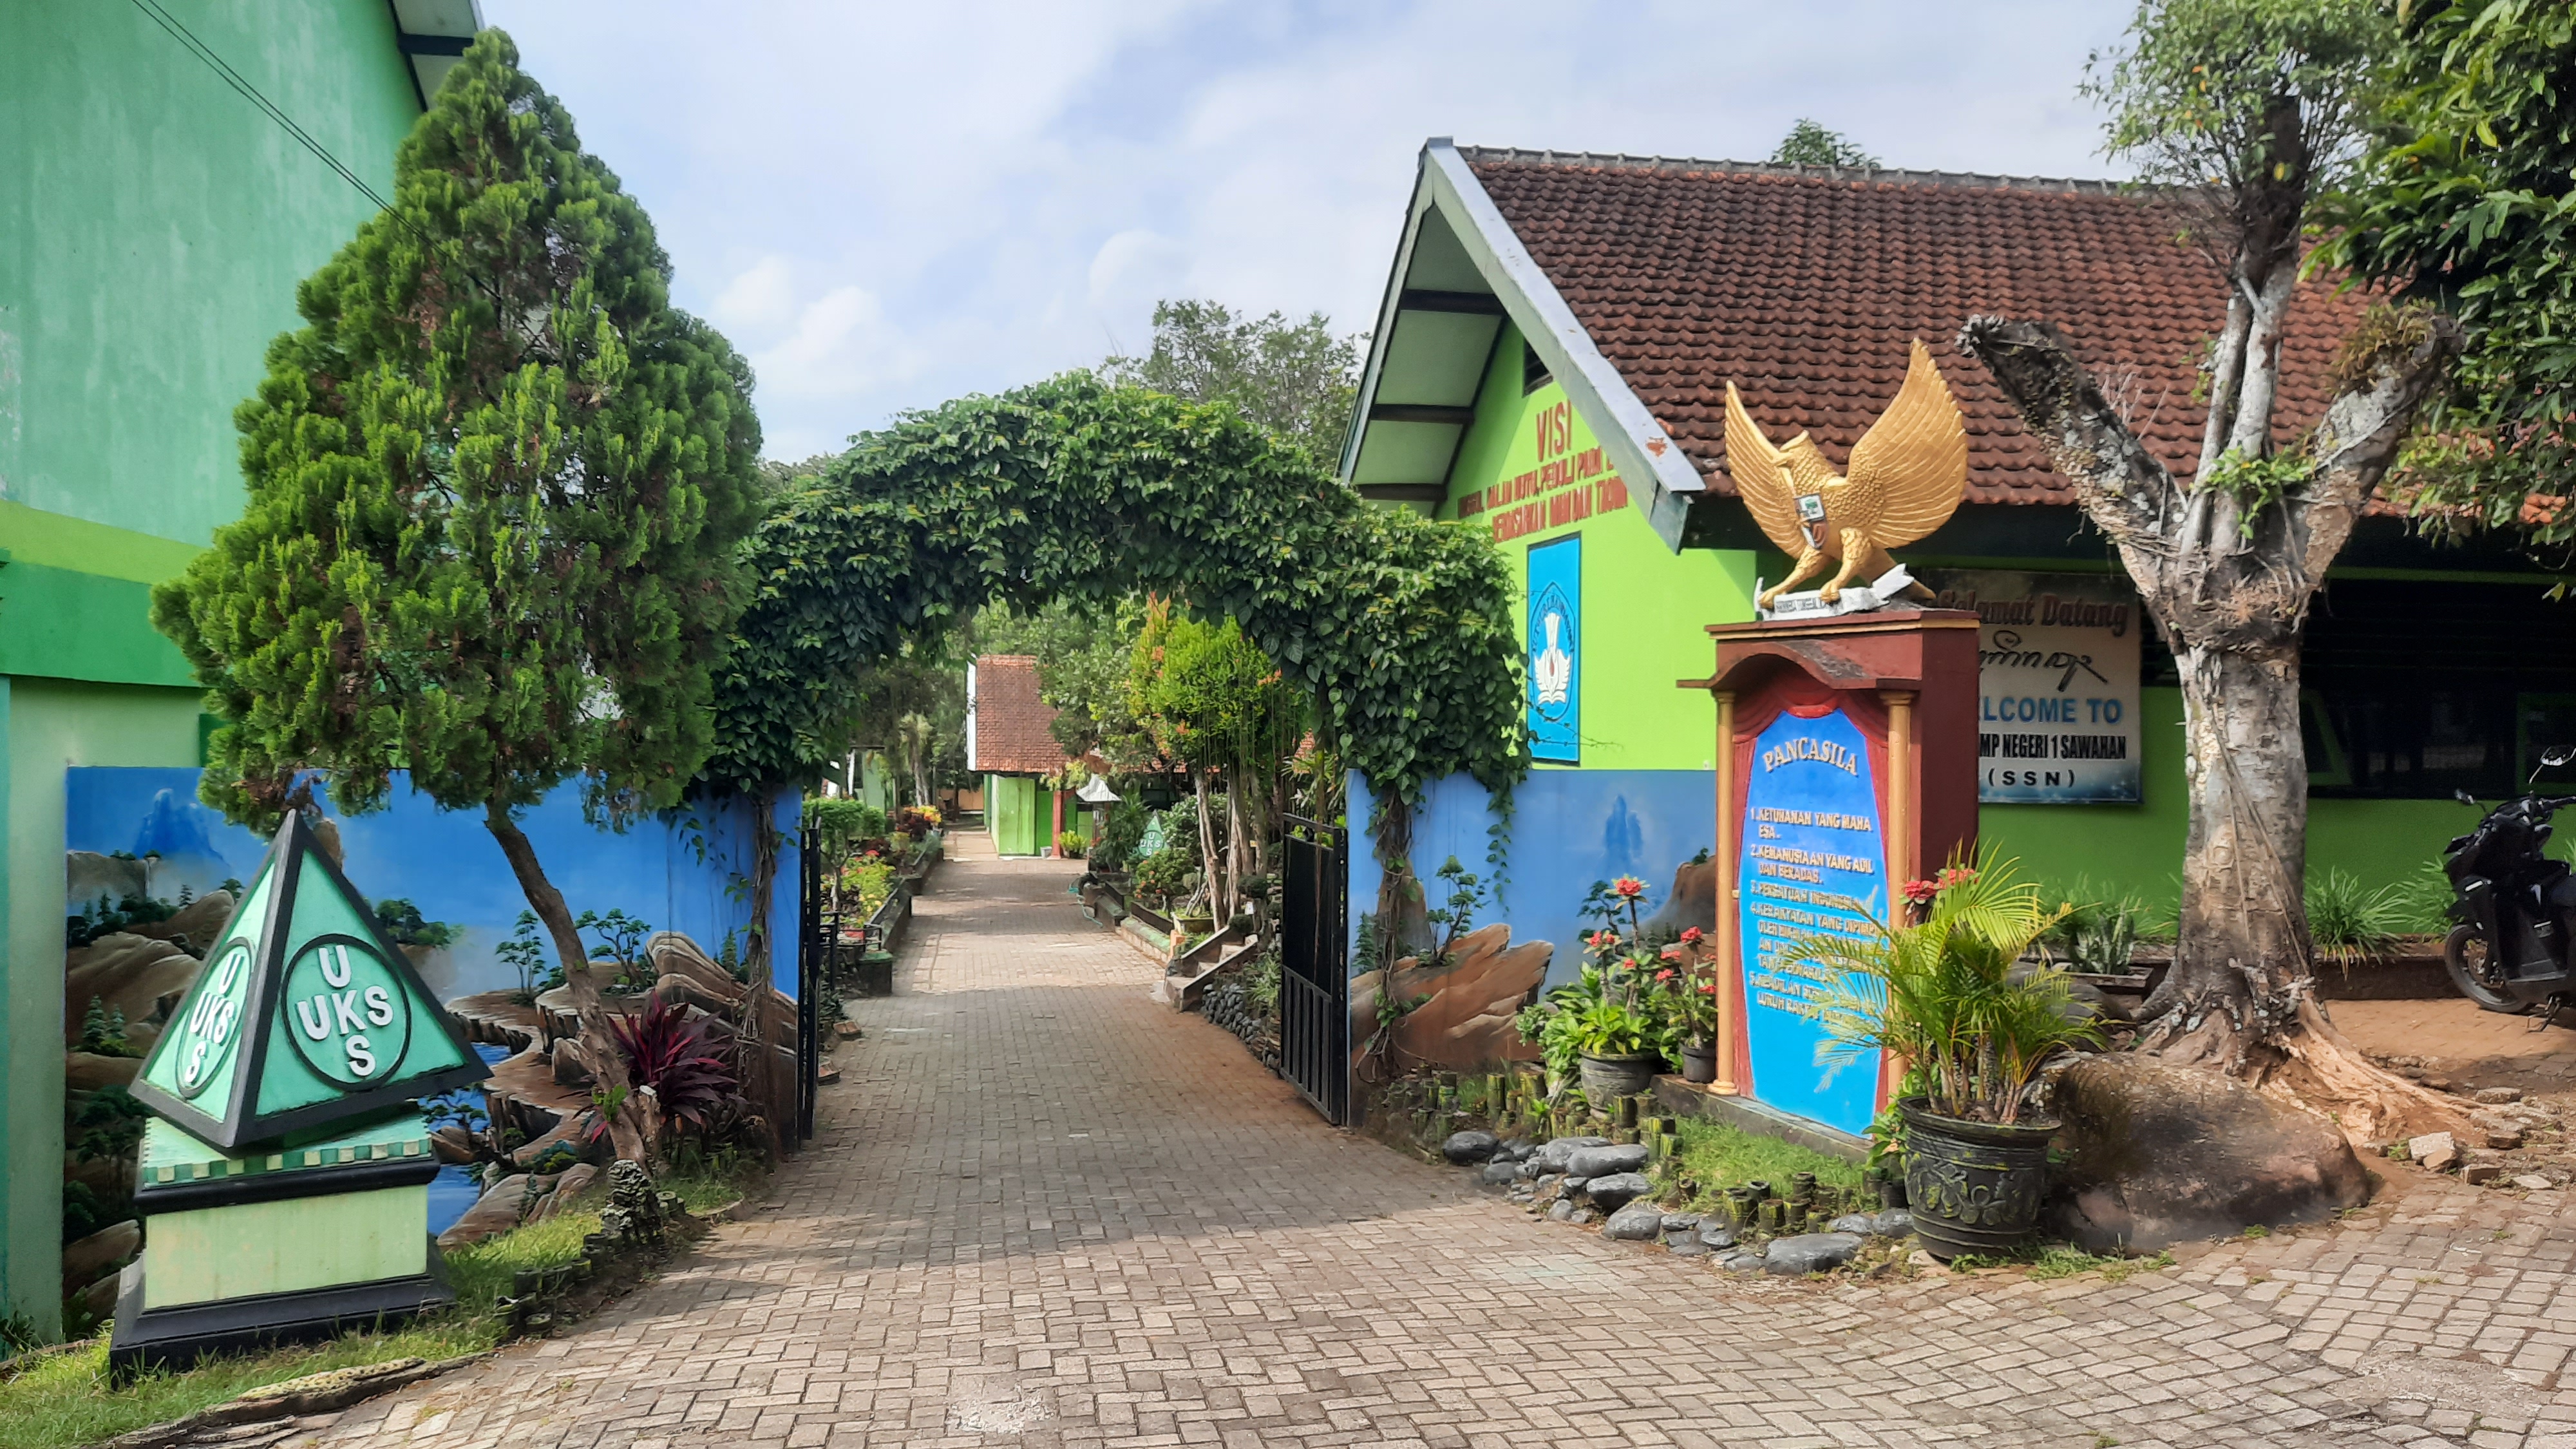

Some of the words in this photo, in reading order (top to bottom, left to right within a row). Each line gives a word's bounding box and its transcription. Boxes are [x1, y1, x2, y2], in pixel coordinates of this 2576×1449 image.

[1537, 399, 1572, 462] VISI
[2041, 593, 2128, 637] Datang
[1984, 697, 2077, 723] LCOME
[2087, 699, 2123, 723] TO
[1763, 737, 1859, 777] PANCASILA
[1980, 734, 2000, 757] MP
[2002, 734, 2049, 758] NEGERI
[2050, 735, 2058, 759] 1
[2060, 735, 2126, 759] SAWAHAN
[1815, 812, 1841, 829] YANG
[1841, 815, 1872, 831] MAHA
[1825, 853, 1852, 871] YANG
[1852, 857, 1874, 874] ADIL
[1817, 914, 1844, 931] YANG
[318, 945, 353, 988] U
[189, 991, 234, 1045] UKS
[297, 985, 394, 1041] UKS
[345, 1035, 376, 1077] S
